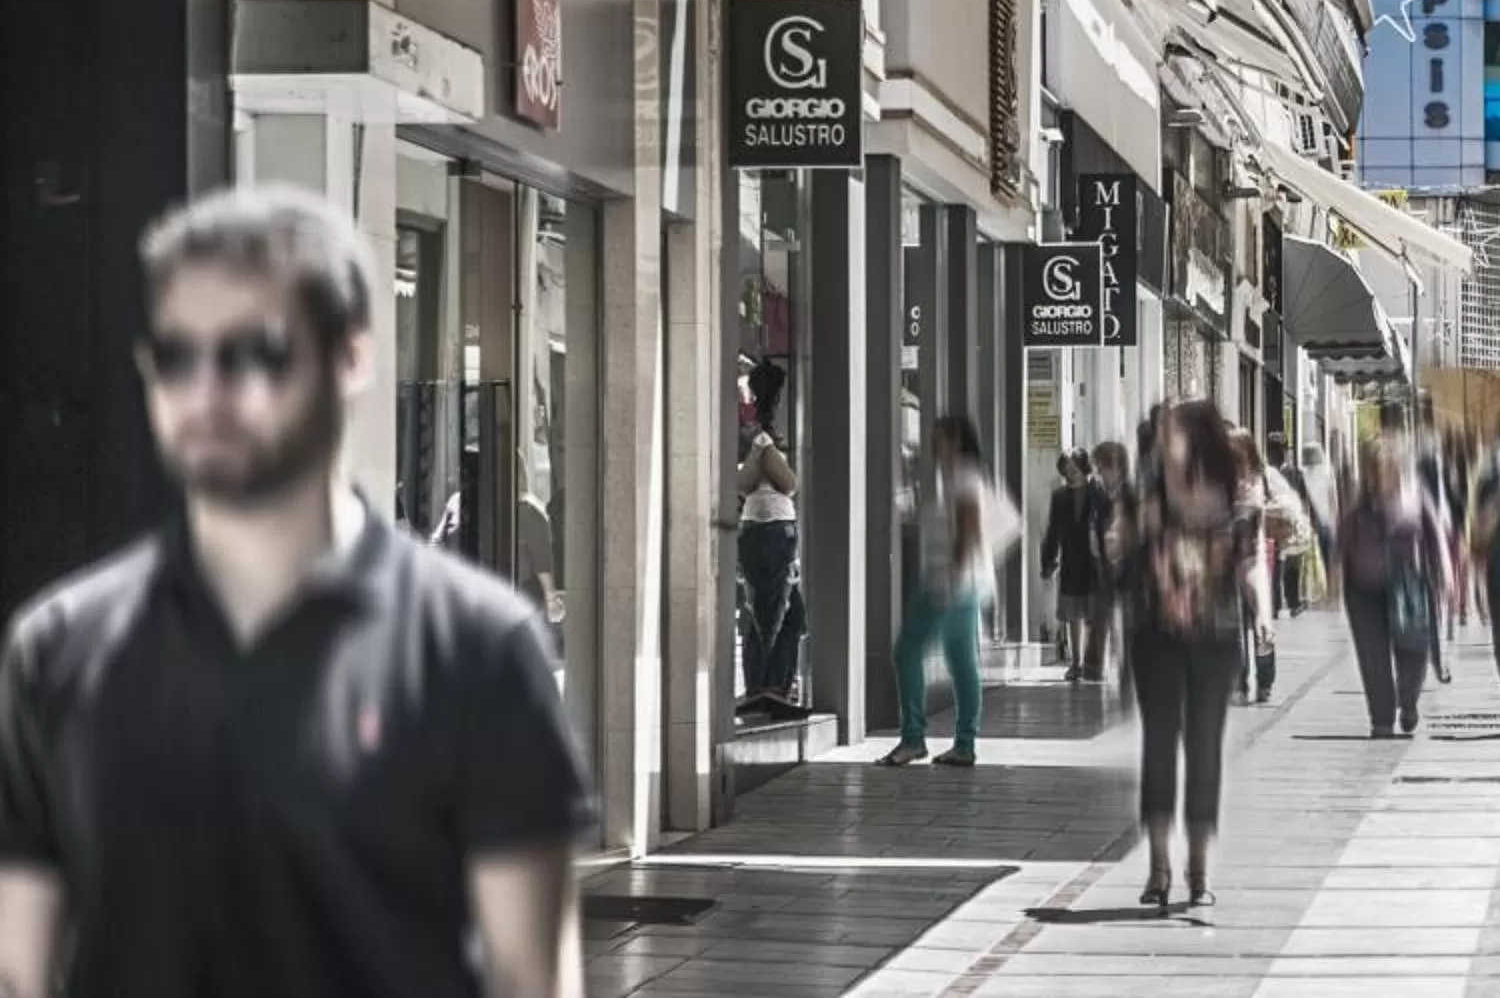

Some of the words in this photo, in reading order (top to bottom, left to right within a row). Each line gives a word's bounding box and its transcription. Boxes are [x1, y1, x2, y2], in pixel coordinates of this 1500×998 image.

[745, 97, 846, 119] GIORGIO
[745, 123, 846, 146] SALUSTRO
[1032, 304, 1093, 319] GIORGIO
[1031, 320, 1093, 335] SALUSTRO
